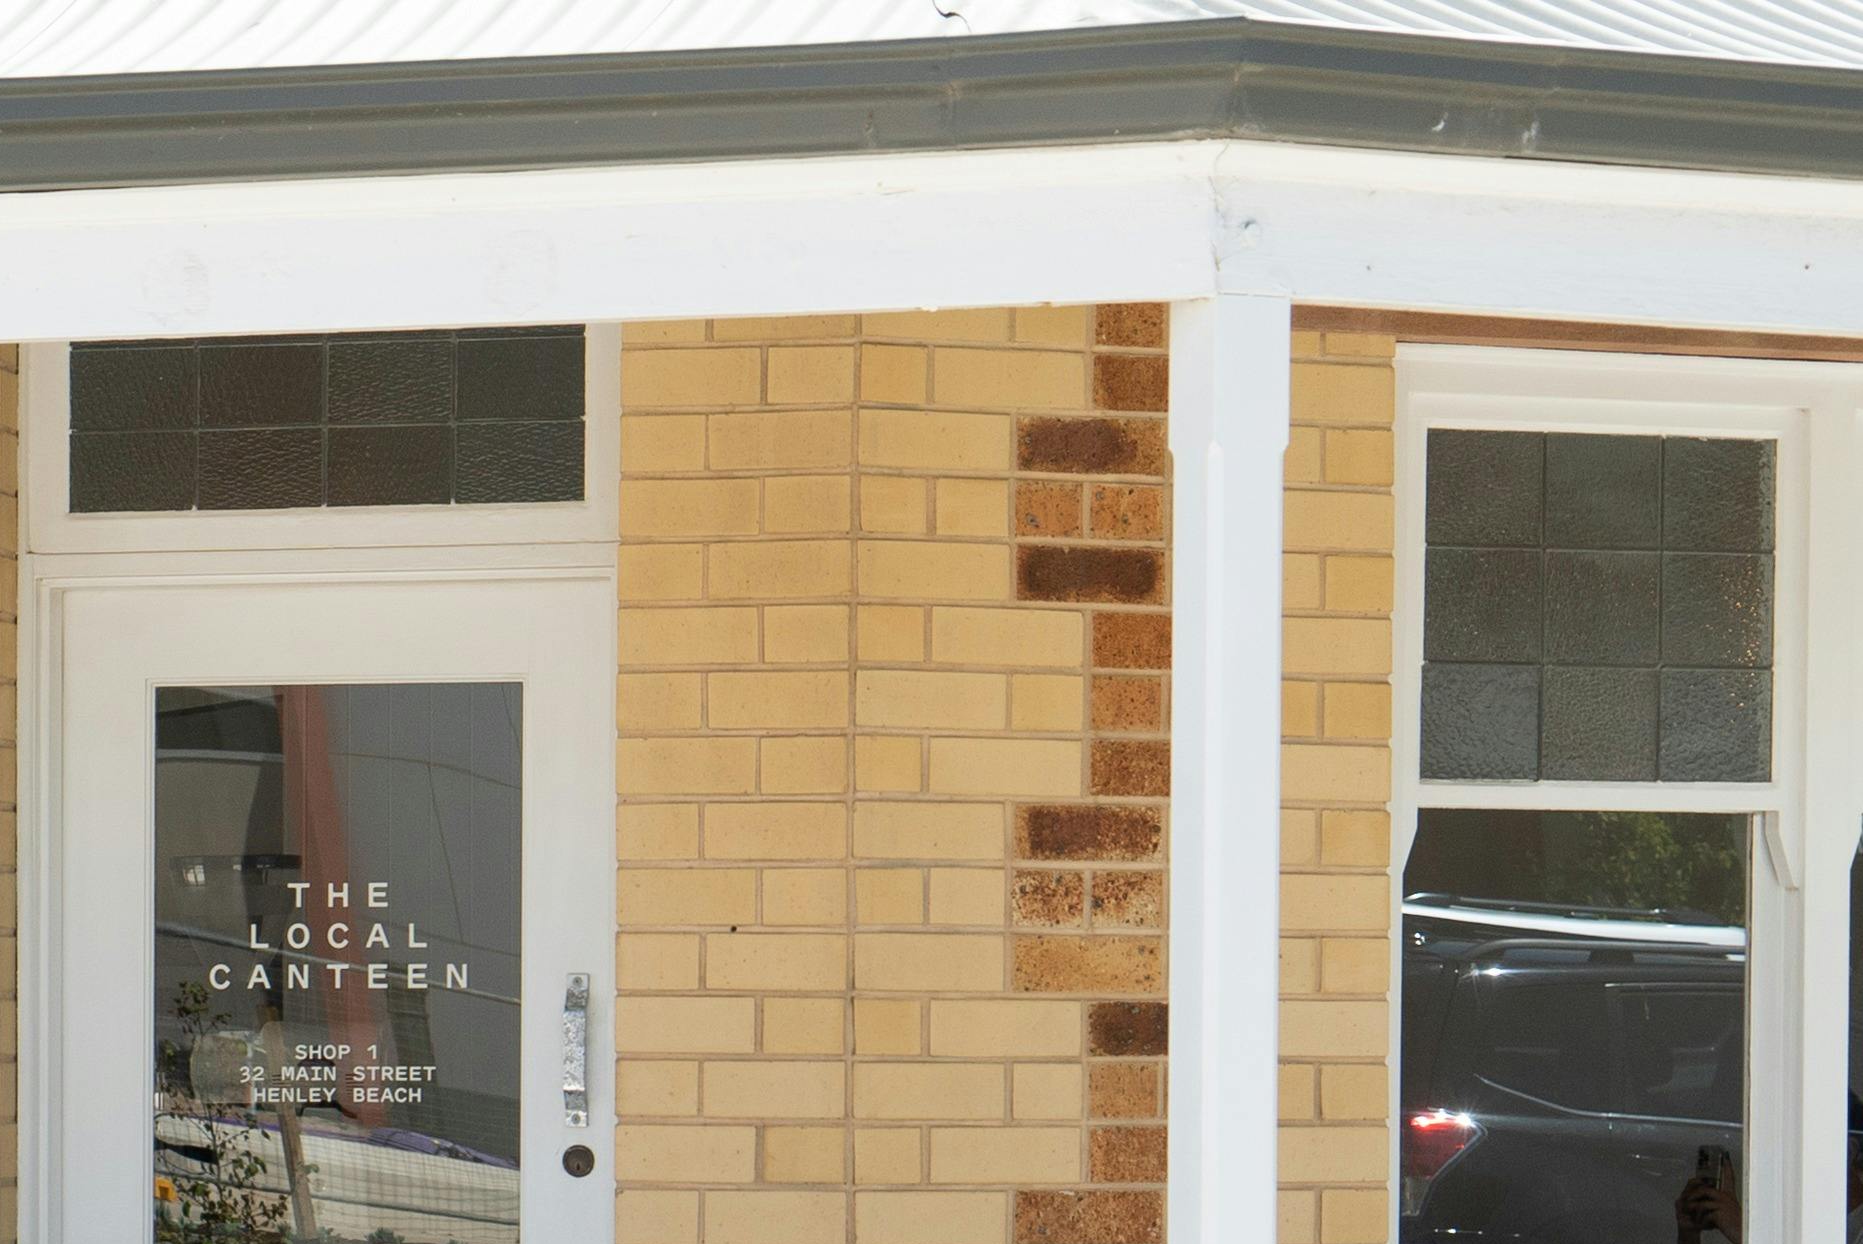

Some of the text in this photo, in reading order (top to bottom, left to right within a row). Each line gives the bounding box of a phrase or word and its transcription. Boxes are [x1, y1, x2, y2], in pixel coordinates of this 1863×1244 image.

[287, 882, 389, 908] THE
[250, 922, 428, 949] LOCAL
[209, 963, 468, 990] CANTEEN
[294, 1044, 378, 1060] SHOP 1
[239, 1066, 437, 1083] 32 MAIN STREET
[252, 1087, 422, 1103] HENLEY BEACH
